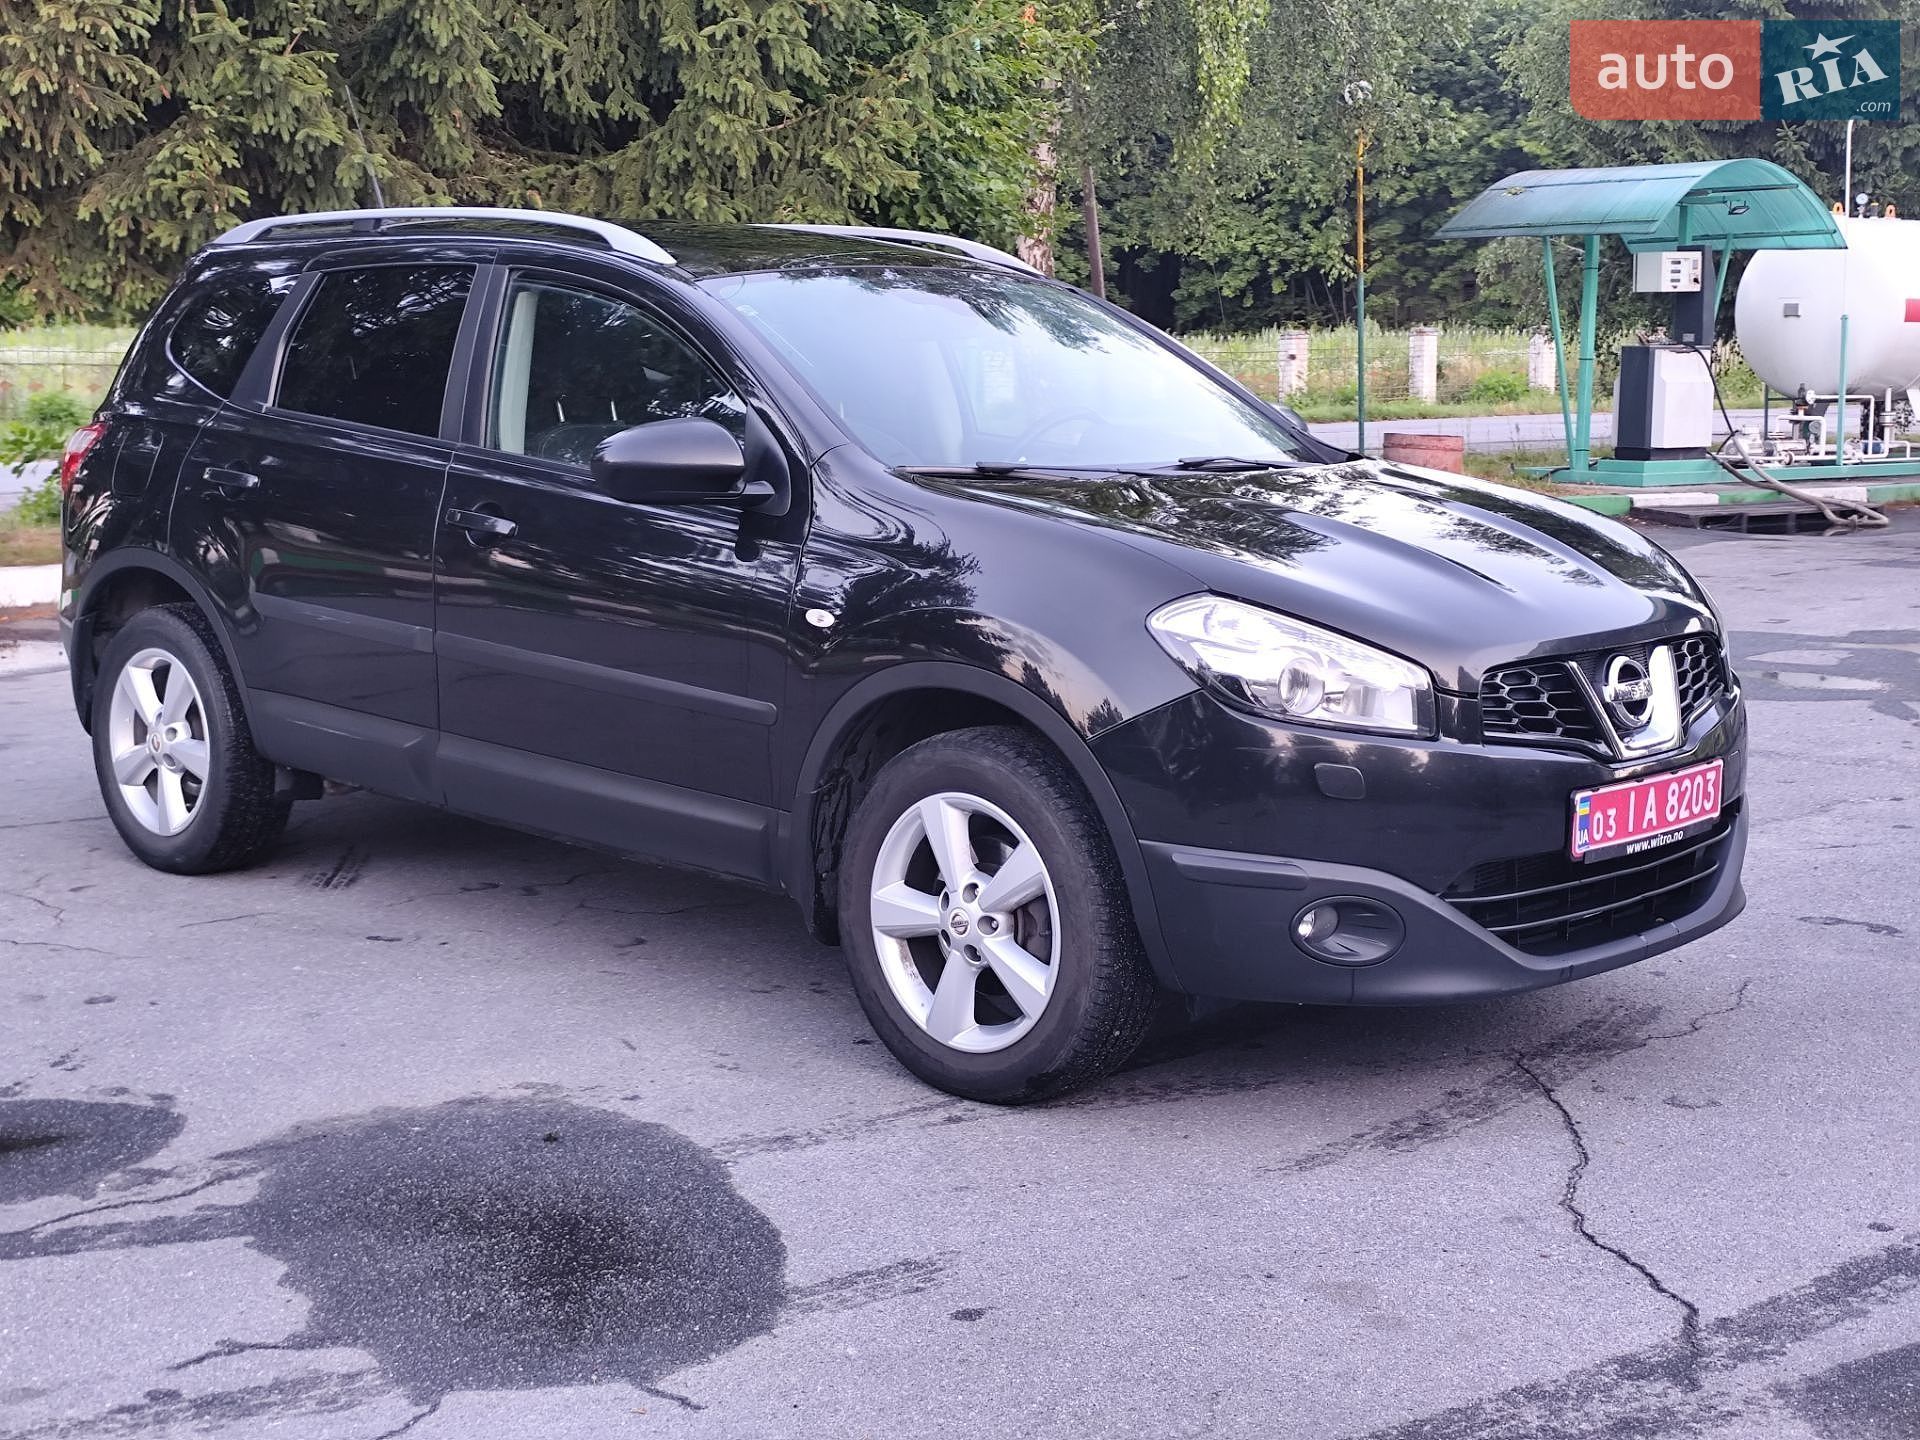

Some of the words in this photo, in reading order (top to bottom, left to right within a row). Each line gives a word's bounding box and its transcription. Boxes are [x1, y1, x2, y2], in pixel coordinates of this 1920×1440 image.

[1593, 808, 1617, 841] 03
[1665, 771, 1717, 823] 8203
[1578, 829, 1589, 845] UA
[1626, 830, 1684, 855] www.witro.no
